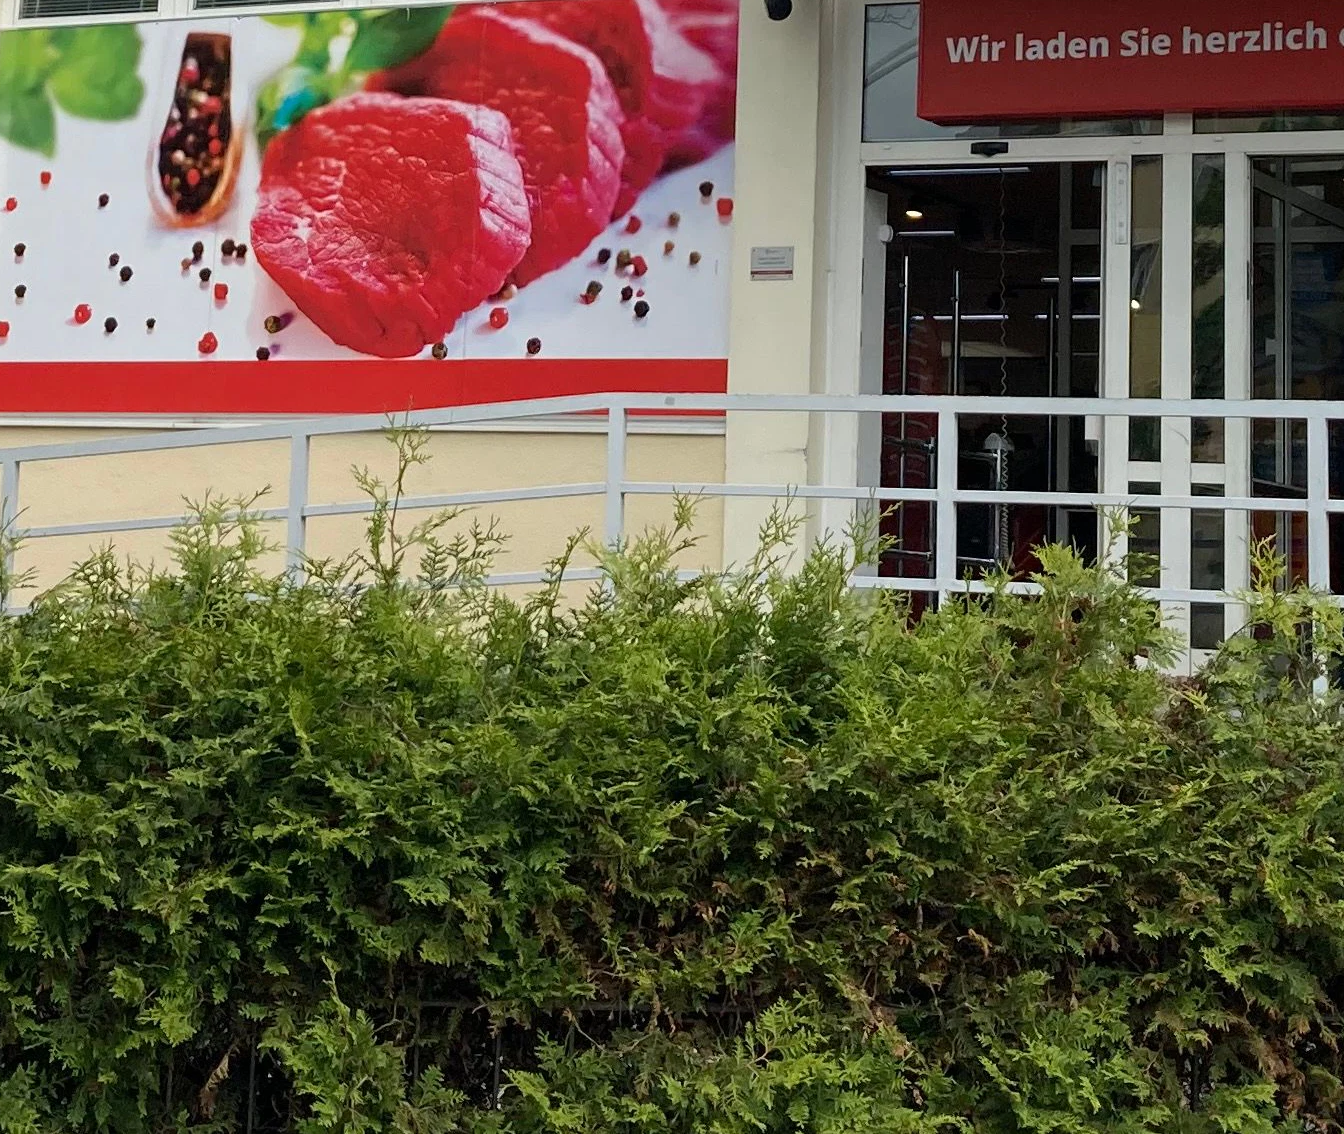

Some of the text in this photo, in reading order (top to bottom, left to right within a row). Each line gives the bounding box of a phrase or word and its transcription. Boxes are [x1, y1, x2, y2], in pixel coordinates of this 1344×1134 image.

[946, 34, 1006, 63] Wir
[1015, 31, 1110, 61] laden
[1120, 27, 1171, 57] Sie
[1182, 20, 1328, 54] herzlich
